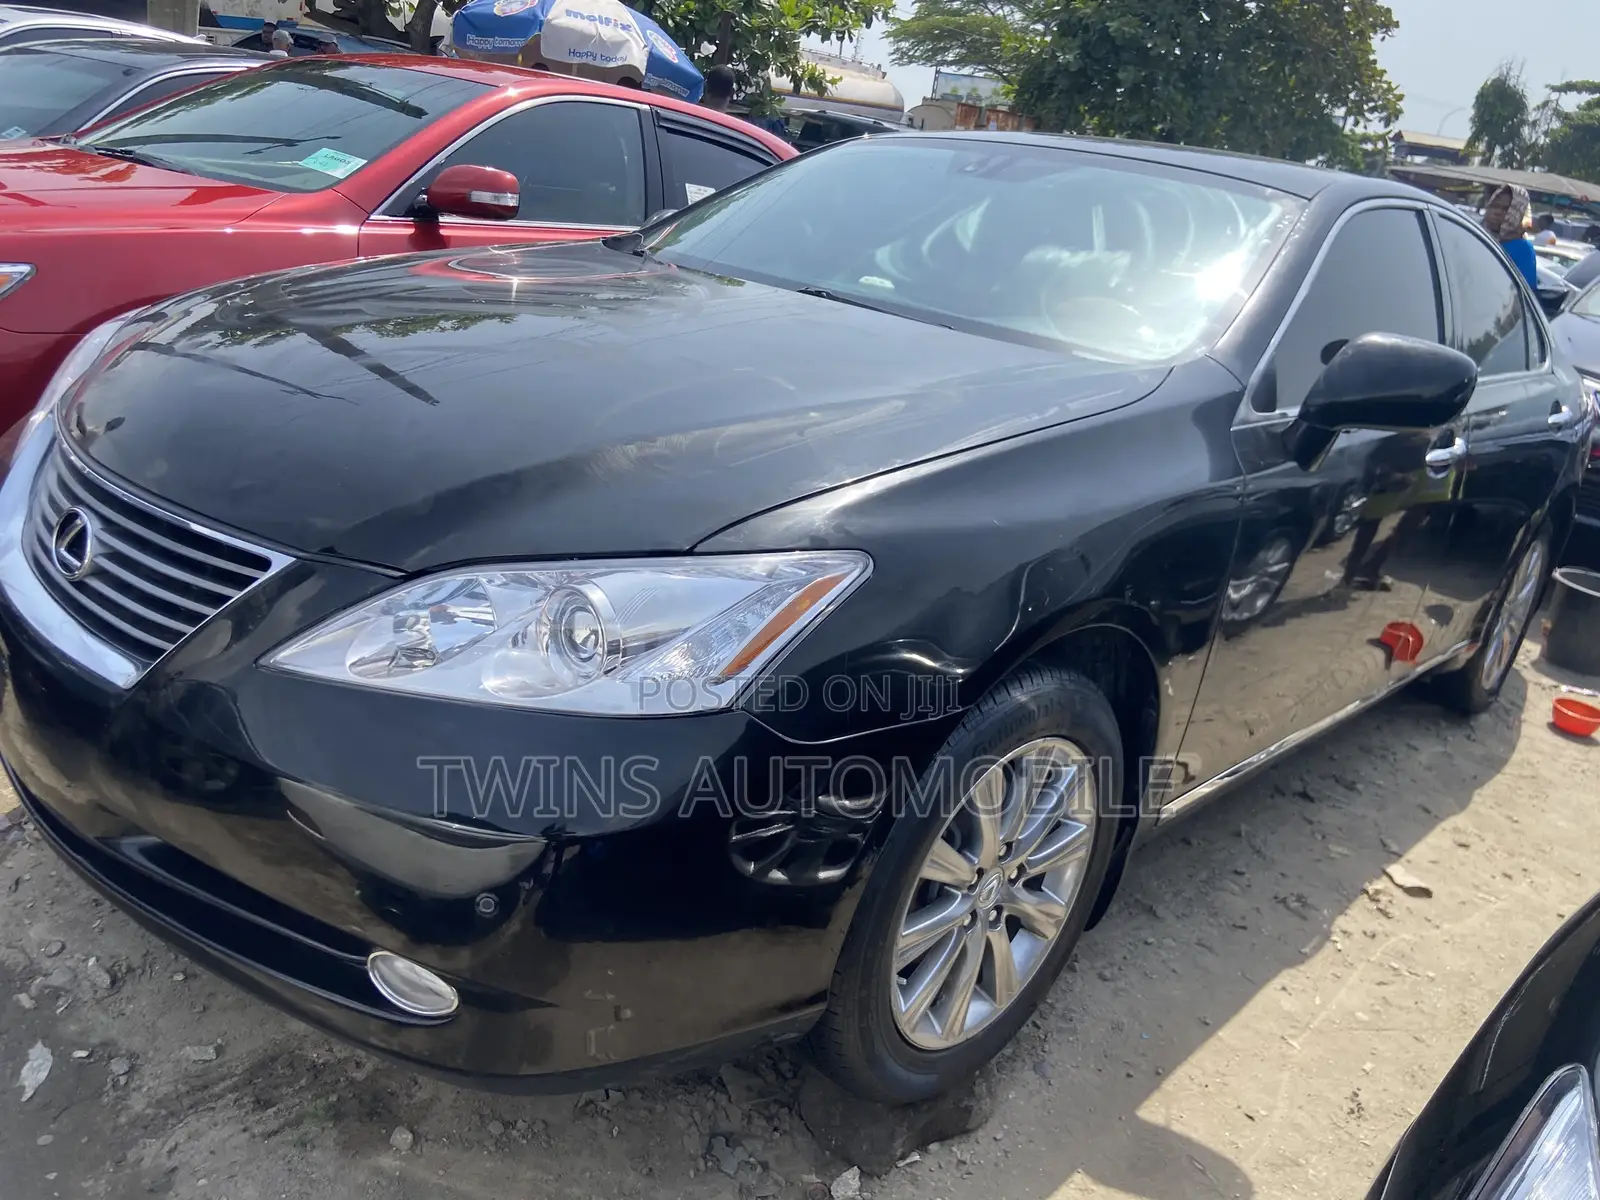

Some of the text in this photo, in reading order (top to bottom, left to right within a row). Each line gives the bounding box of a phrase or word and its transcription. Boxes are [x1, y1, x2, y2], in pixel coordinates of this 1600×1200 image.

[565, 9, 632, 32] molfix
[466, 34, 494, 49] Happy
[568, 48, 628, 63] Happy today
